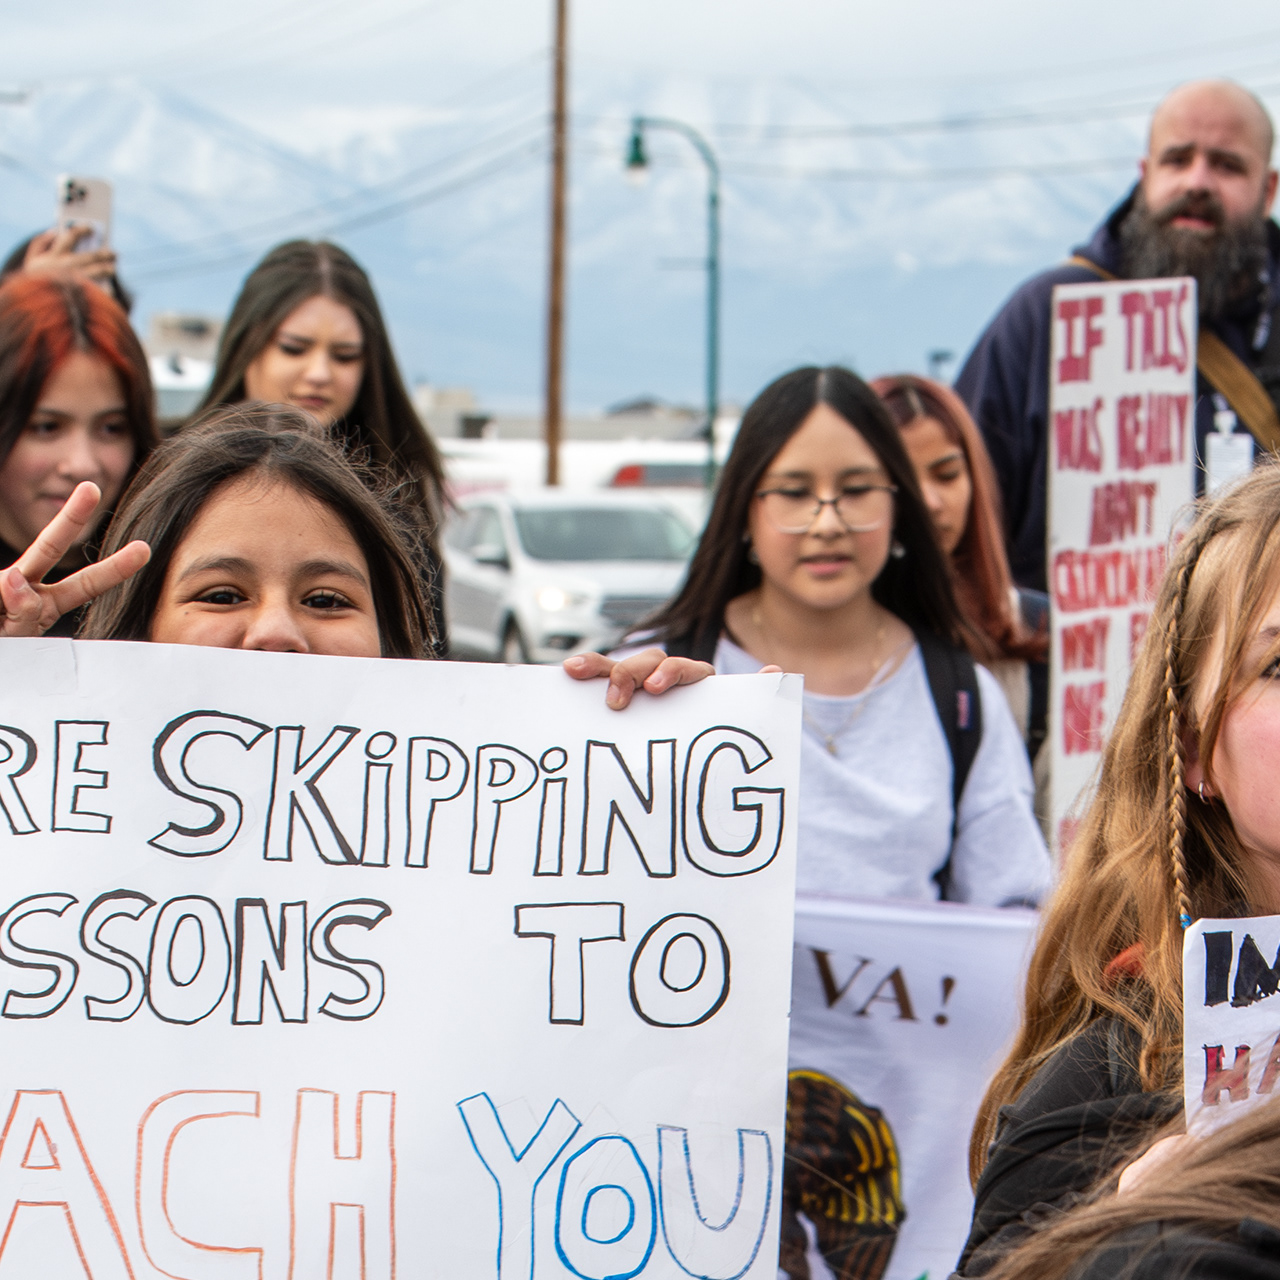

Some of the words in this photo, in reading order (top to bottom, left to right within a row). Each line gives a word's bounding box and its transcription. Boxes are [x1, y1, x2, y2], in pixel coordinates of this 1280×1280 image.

[1057, 296, 1104, 384] IF
[1120, 284, 1188, 376] THIS
[513, 901, 731, 1028] TO
[807, 945, 957, 1027] VA!
